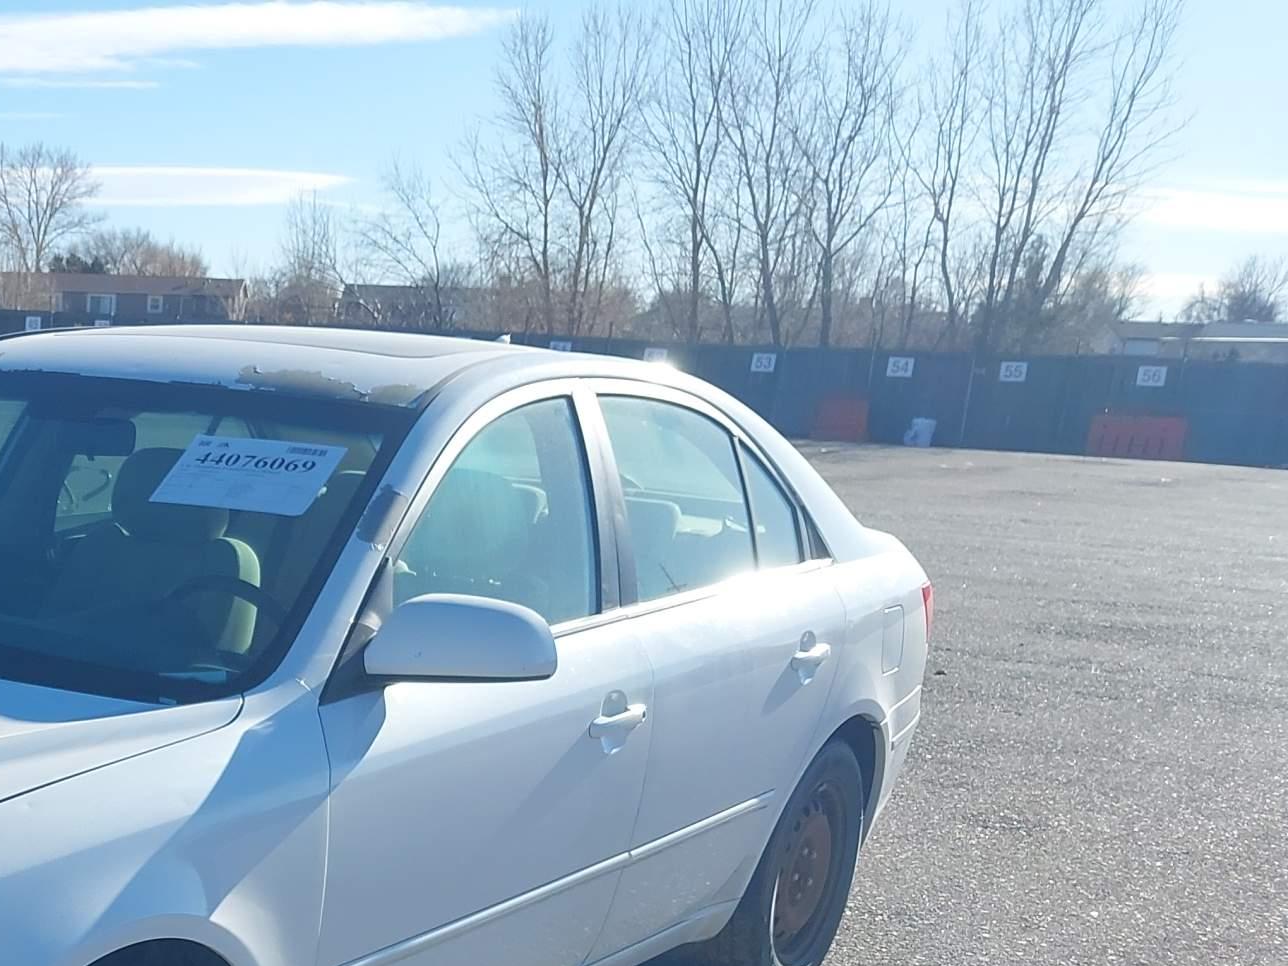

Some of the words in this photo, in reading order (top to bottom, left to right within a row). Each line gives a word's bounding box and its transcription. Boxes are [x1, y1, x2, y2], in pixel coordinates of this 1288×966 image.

[754, 355, 772, 369] 53
[890, 359, 910, 374] 54
[1002, 364, 1024, 379] 55
[1142, 368, 1162, 383] 56
[195, 451, 317, 473] 44076069
